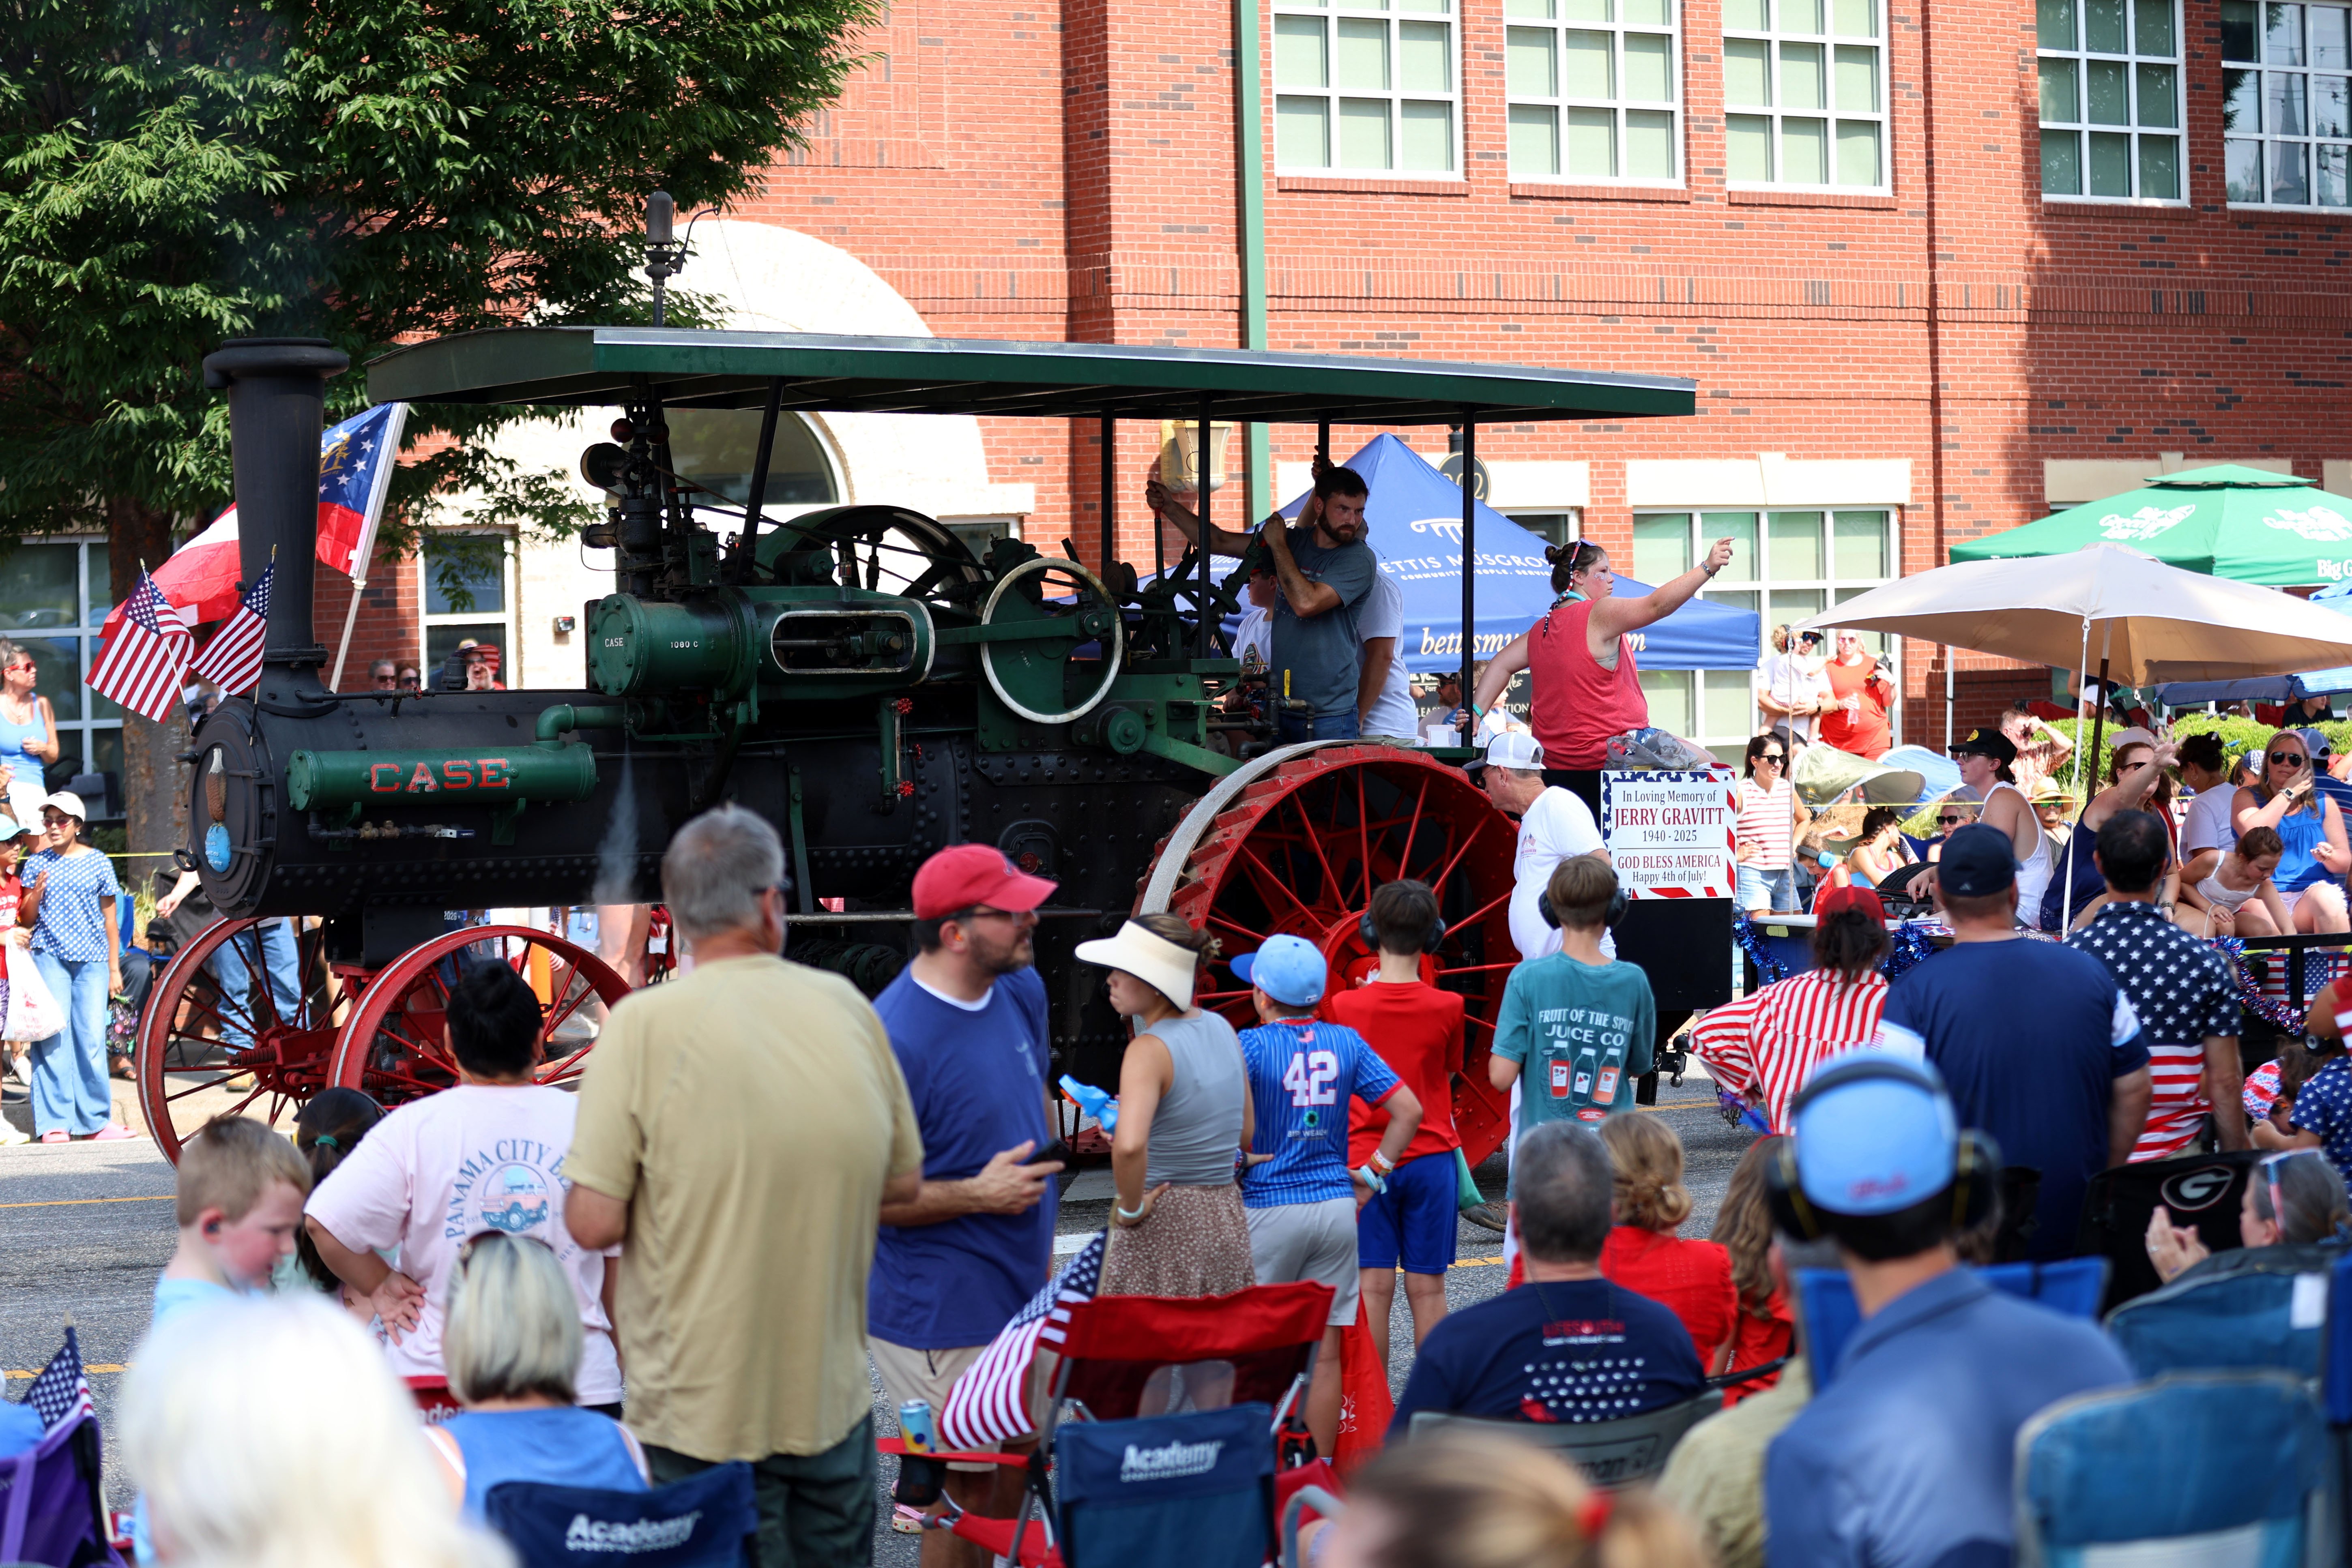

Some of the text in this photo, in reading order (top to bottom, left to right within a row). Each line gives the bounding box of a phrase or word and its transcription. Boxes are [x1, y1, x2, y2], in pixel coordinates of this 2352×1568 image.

[1380, 557, 1442, 573] ETTIS
[2317, 559, 2342, 581] Big
[605, 637, 623, 647] CASE
[1504, 704, 1529, 713] TION
[370, 758, 509, 793] CASE
[1623, 790, 1716, 805] In Loving Memory of
[1615, 807, 1724, 830] JERRY GRAVITT
[1643, 830, 1665, 842] 1940
[1674, 830, 1697, 841] 2025
[1618, 855, 1721, 869] GOD BLESS AMERICA
[1633, 870, 1706, 885] Happy 4th of July!
[1539, 1009, 1569, 1023] FRUIT
[1570, 1009, 1585, 1023] OF
[1588, 1011, 1609, 1027] THE
[1545, 1024, 1594, 1043] JUICE
[1282, 1051, 1337, 1106] 42
[445, 1150, 495, 1241] PANAMA
[496, 1140, 552, 1165] CITY
[1121, 1440, 1218, 1473] Academy
[567, 1514, 694, 1543] Academy
